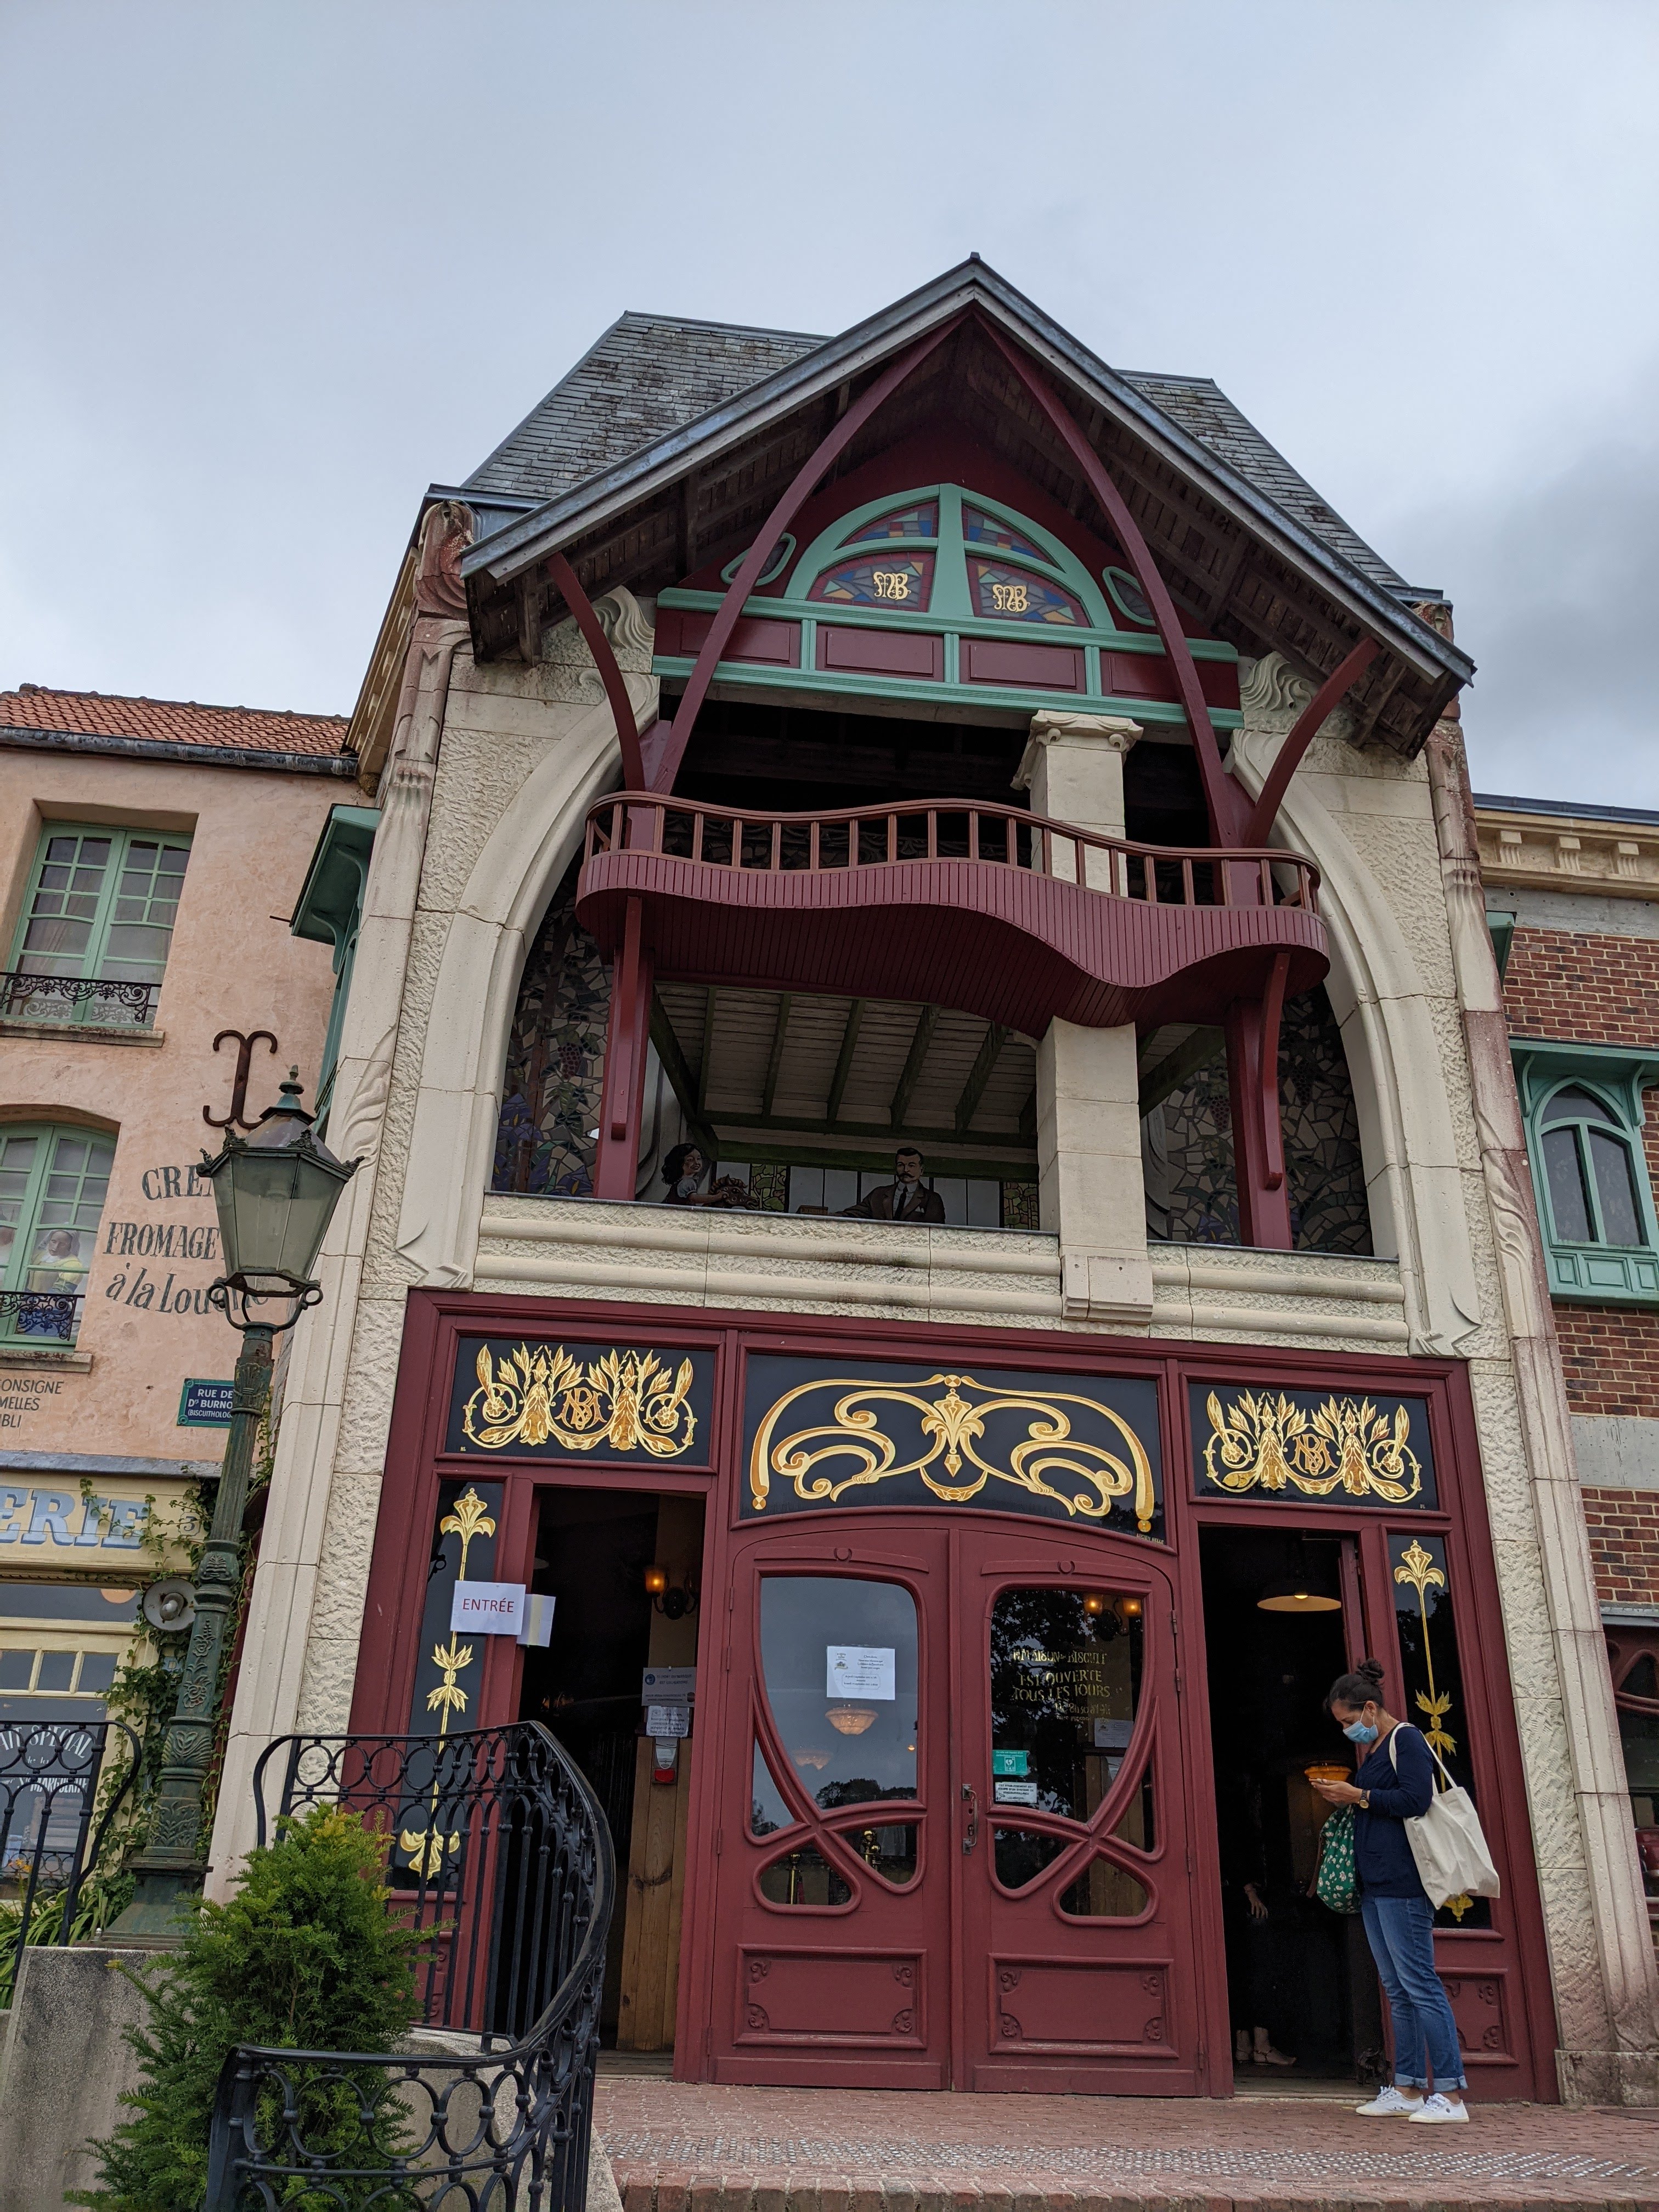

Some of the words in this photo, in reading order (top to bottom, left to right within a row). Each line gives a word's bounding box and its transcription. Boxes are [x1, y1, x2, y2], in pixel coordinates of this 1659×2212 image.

[142, 1165, 213, 1200] CRE
[103, 1222, 224, 1260] FROMAGE
[0, 1378, 65, 1395] ONSIGNE
[198, 1389, 218, 1398] RUE
[0, 1414, 22, 1428] BLI
[462, 1598, 515, 1613] ENTRÉE
